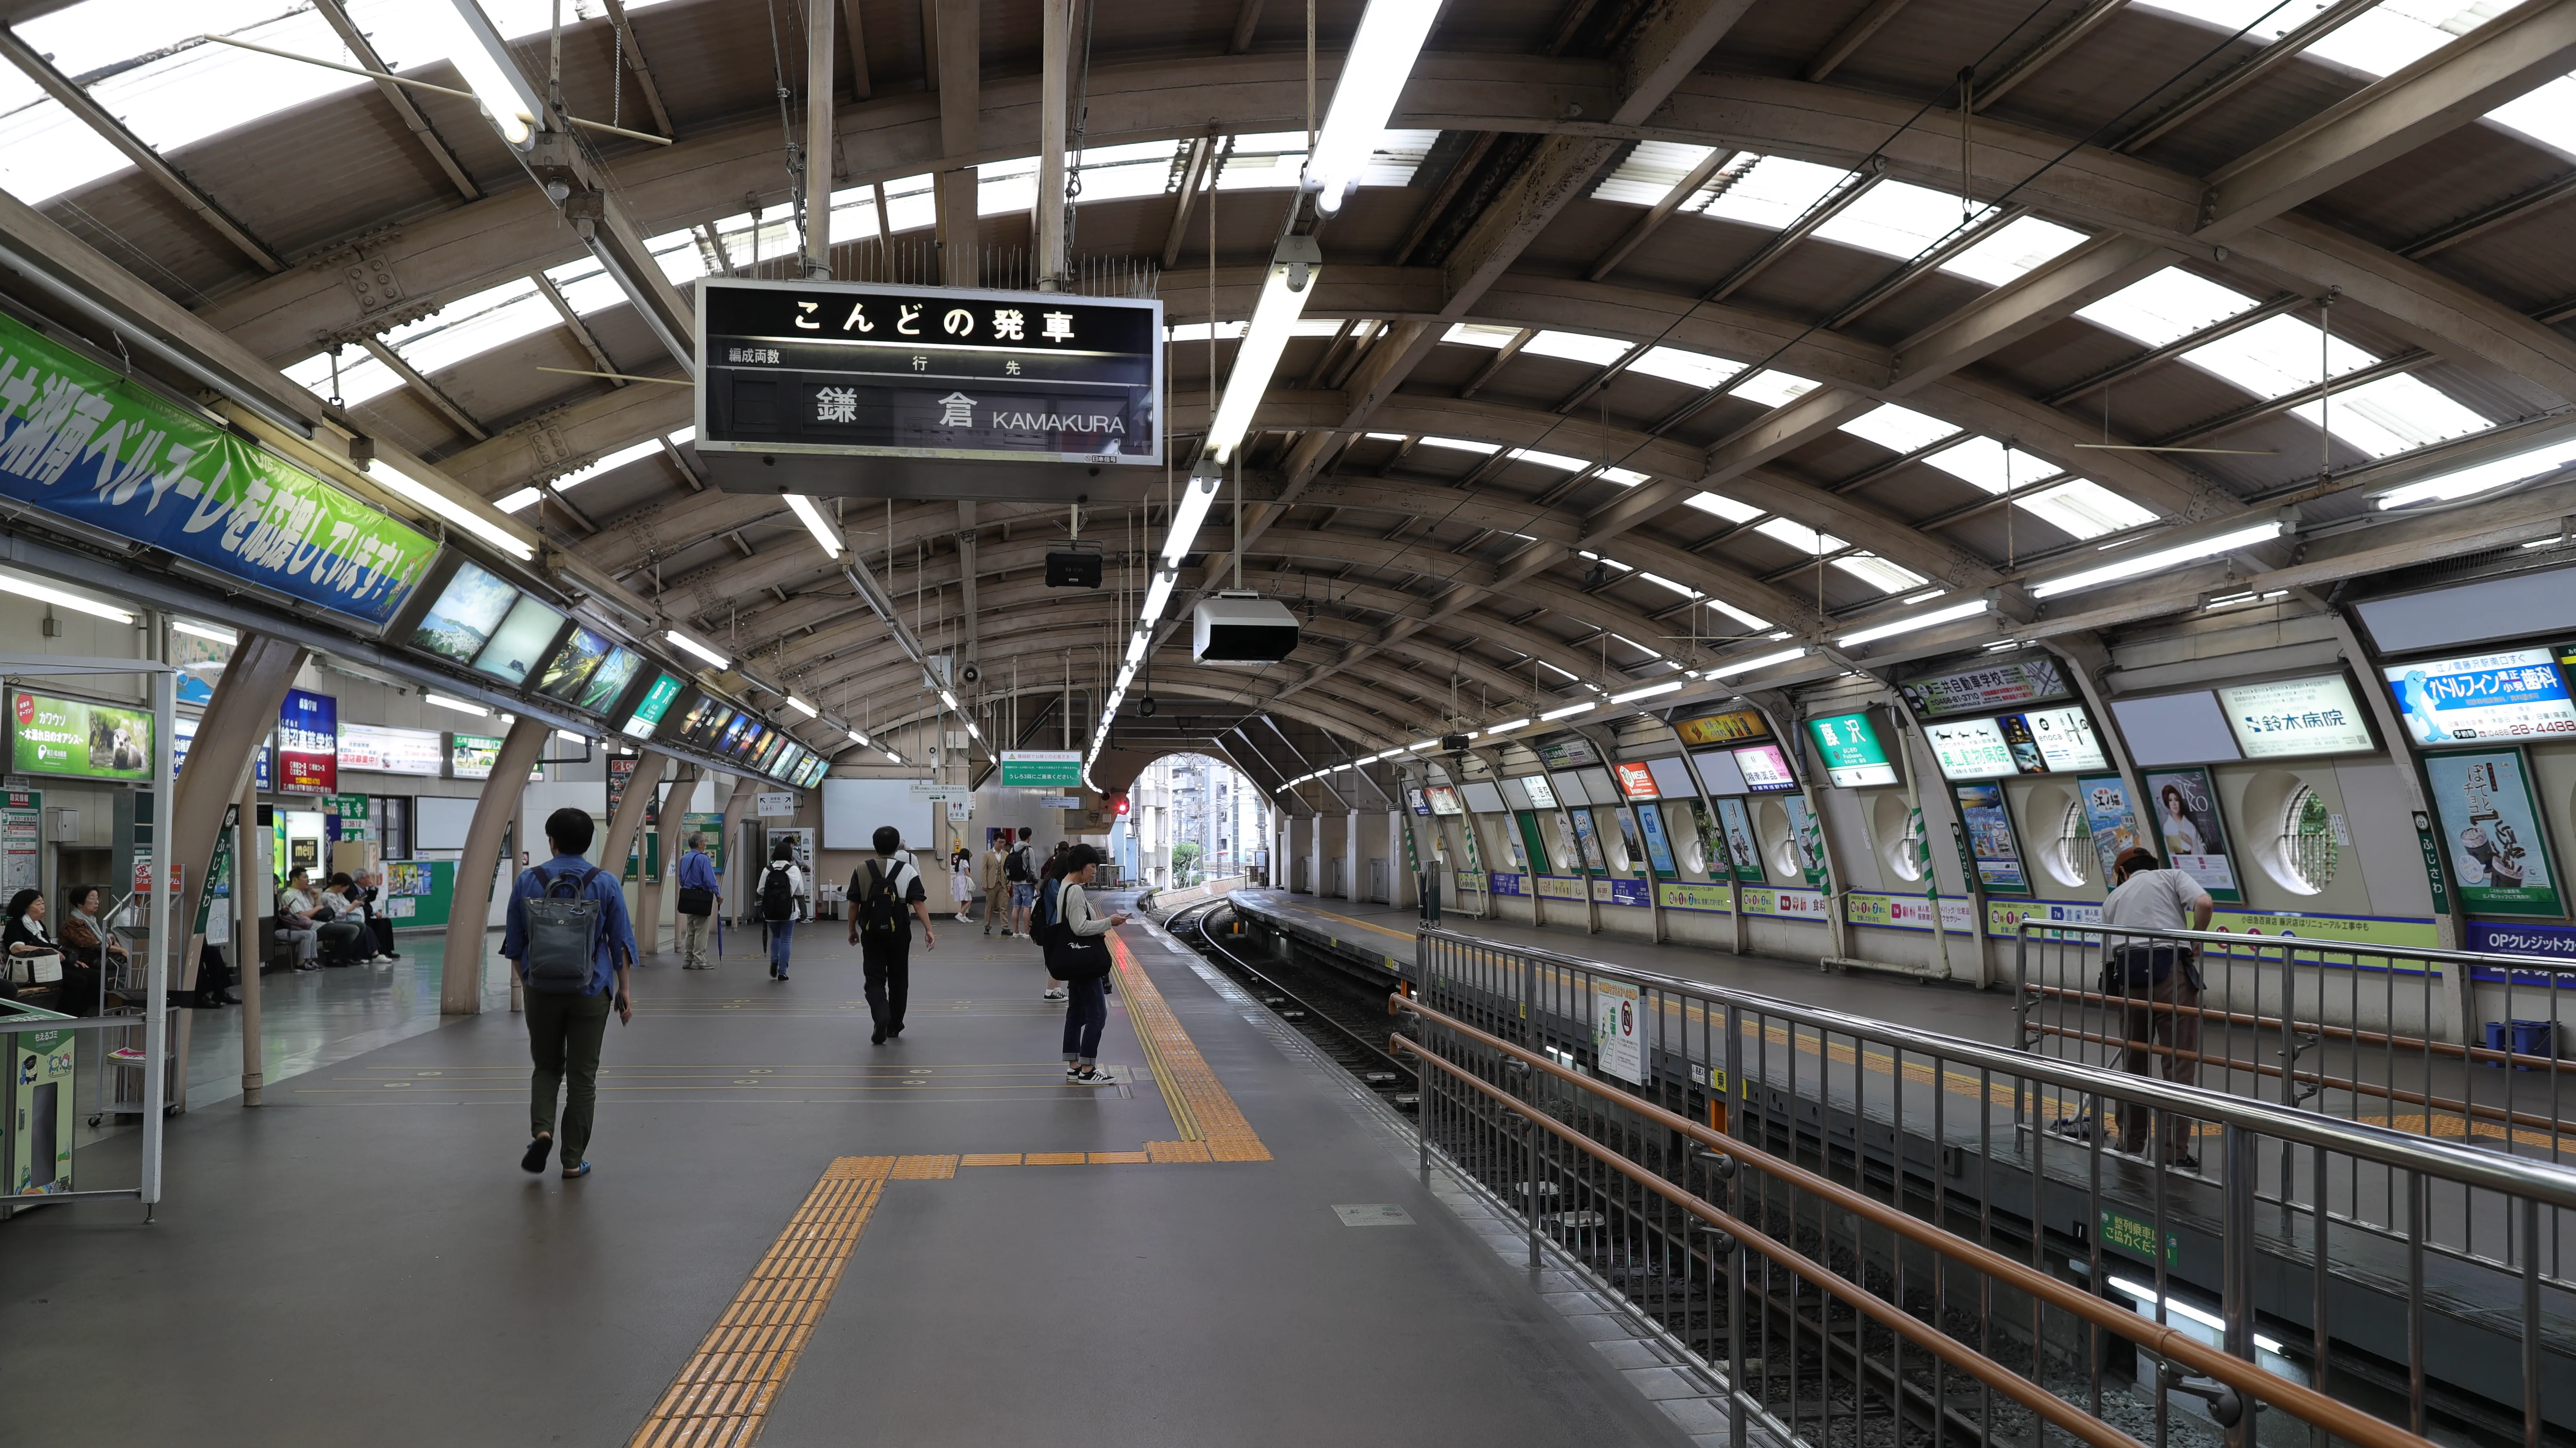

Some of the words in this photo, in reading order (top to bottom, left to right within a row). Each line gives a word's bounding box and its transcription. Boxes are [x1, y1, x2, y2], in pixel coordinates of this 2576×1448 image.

[795, 300, 1075, 343] こんどの発車
[728, 347, 780, 365] 編成両数
[992, 412, 1126, 434] KAMAKURA
[1092, 455, 1117, 464] 日本信号
[2436, 654, 2526, 672] 江ノ電藤沢駅南口すぐ
[1930, 670, 2004, 695] 三共自動車学校
[2434, 674, 2500, 699] ドルフィン
[2520, 666, 2558, 691] 歯科
[2503, 681, 2526, 693] 小児
[39, 711, 66, 726] カワウソ
[2262, 709, 2346, 732] 鈴木病院
[1819, 719, 1867, 747] 藤沢
[2039, 732, 2063, 742] enoca
[2454, 730, 2476, 738] 予約制
[2510, 720, 2576, 736] 28-4488
[1942, 745, 2009, 767] 奥山動物病院
[1745, 771, 1778, 782] 湘南薬品
[292, 840, 314, 861] meiji
[202, 838, 225, 908] ふじさわ
[2423, 838, 2443, 894] ふじさわ
[2241, 915, 2278, 926] 小田急百貨店
[2279, 917, 2370, 932] 藤沢店はリニューアル工事中も
[2488, 933, 2576, 952] OPクレジットカ
[35, 1030, 58, 1042] もえるゴミ
